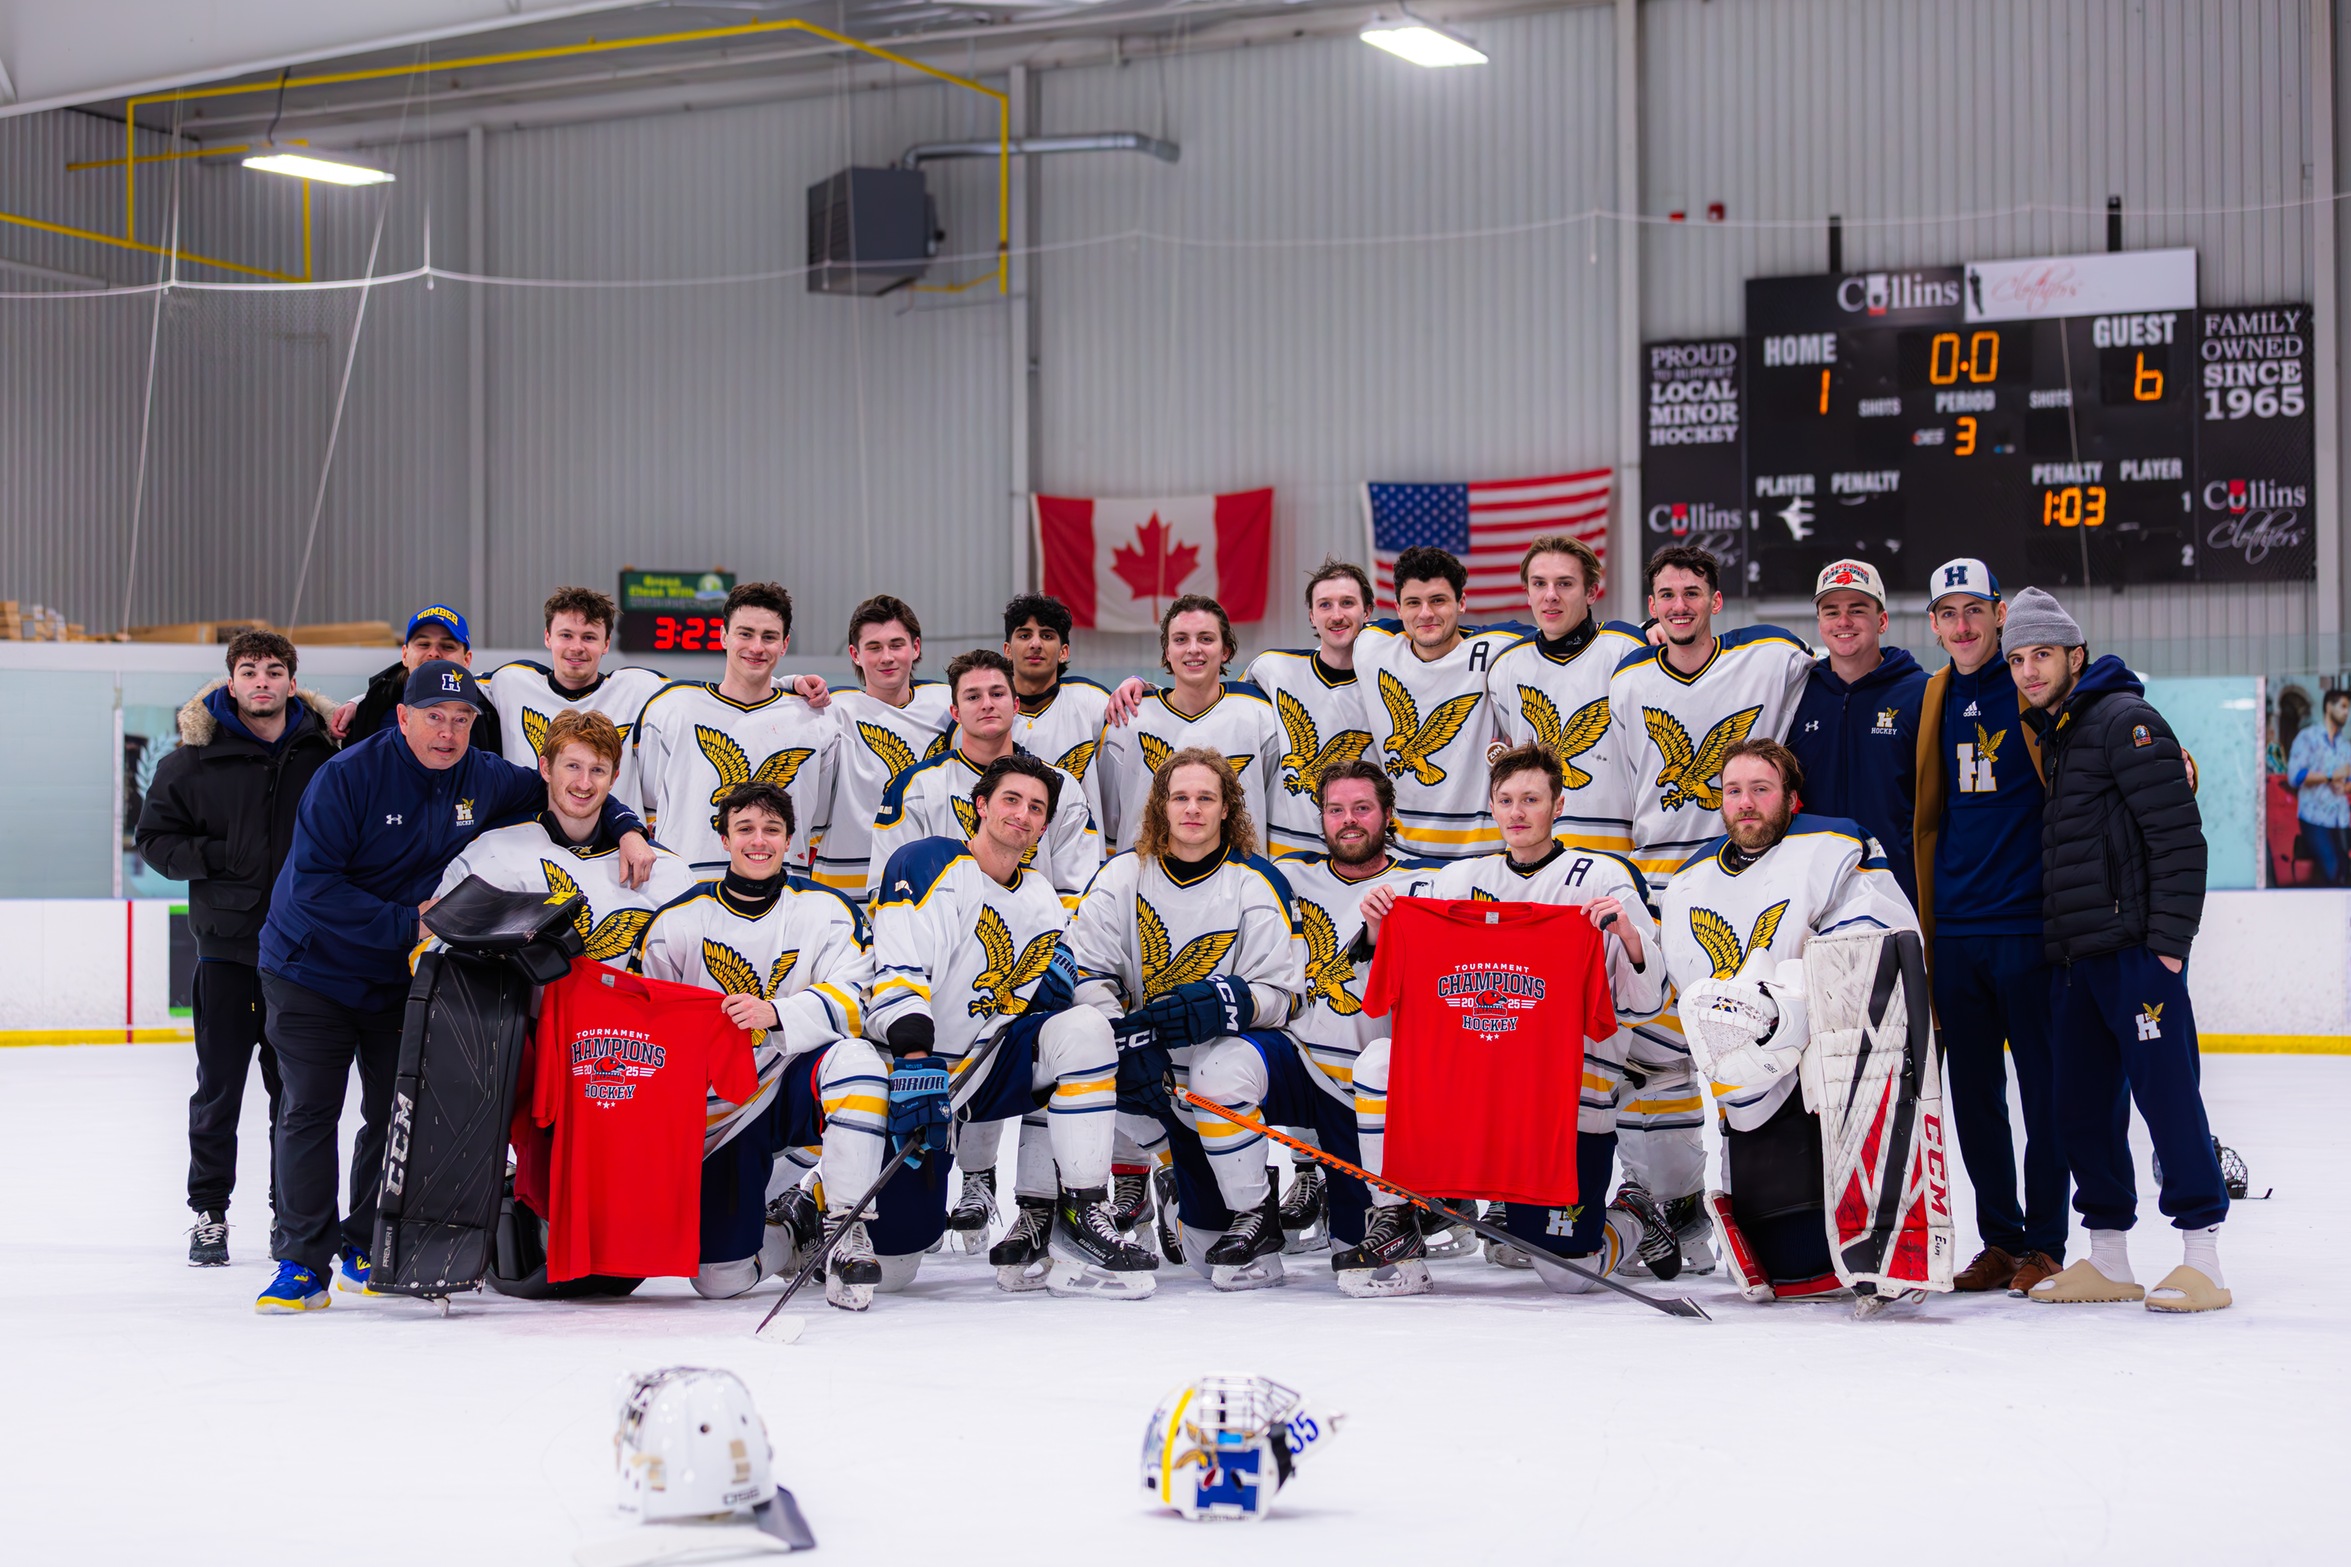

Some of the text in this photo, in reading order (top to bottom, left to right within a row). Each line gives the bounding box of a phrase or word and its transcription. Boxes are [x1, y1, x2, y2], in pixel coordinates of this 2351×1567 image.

[1837, 273, 1960, 314] Collins
[2093, 313, 2177, 348] GUEST
[2205, 310, 2300, 337] FAMILY
[1651, 343, 1737, 369] PROUD
[1764, 333, 1837, 366] HOME
[2201, 335, 2303, 361] OWNED
[2134, 351, 2164, 401] 6
[2204, 360, 2301, 388] SINCE
[1651, 380, 1738, 403] LOCAL
[1820, 369, 1831, 415] 1
[1935, 390, 1996, 412] PERIOD
[2029, 389, 2071, 408] SHOTS
[2204, 385, 2305, 420] 1965
[1649, 402, 1738, 425] MINOR
[1859, 398, 1901, 417] SHOTS
[1649, 425, 1739, 446] HOCKEY
[1954, 416, 1977, 456] 3
[1756, 470, 1900, 497] PLAYER PENALTY
[2032, 458, 2183, 485] PENALTY PLAYER
[2043, 486, 2106, 528] 1:03
[2182, 490, 2191, 513] 1
[2203, 479, 2307, 511] Collins
[1648, 502, 1742, 534] Collins
[1750, 511, 1759, 531] 1
[2182, 544, 2194, 566] 2
[1748, 561, 1760, 582] 2
[1945, 565, 1969, 588] H
[417, 607, 458, 626] HUMBER
[1469, 641, 1490, 672] A
[442, 673, 461, 692] H
[1871, 727, 1898, 735] HOCKEY
[1487, 745, 1502, 760] ZYN
[1957, 743, 1998, 793] H
[456, 819, 475, 827] HOCKEY
[1565, 857, 1594, 887] A
[1455, 963, 1530, 973] TOURNAMENT
[1438, 971, 1545, 1000] CHAMPIONS
[1461, 998, 1474, 1008] 20
[1507, 999, 1521, 1009] 25
[577, 1028, 650, 1040] TOURNAMENT
[1462, 1015, 1519, 1032] HOCKEY
[2135, 1012, 2161, 1041] H
[570, 1037, 667, 1068] HAMPIONS
[584, 1064, 639, 1077] 20 25
[585, 1083, 636, 1099] HOCKEY
[387, 1092, 413, 1196] CCM
[1924, 1114, 1948, 1217] CCM
[1546, 1209, 1574, 1237] H
[383, 1232, 392, 1268] PREMIER
[1079, 1238, 1107, 1259] BAUER
[1384, 1239, 1405, 1256] CCM
[1286, 1411, 1318, 1454] 35
